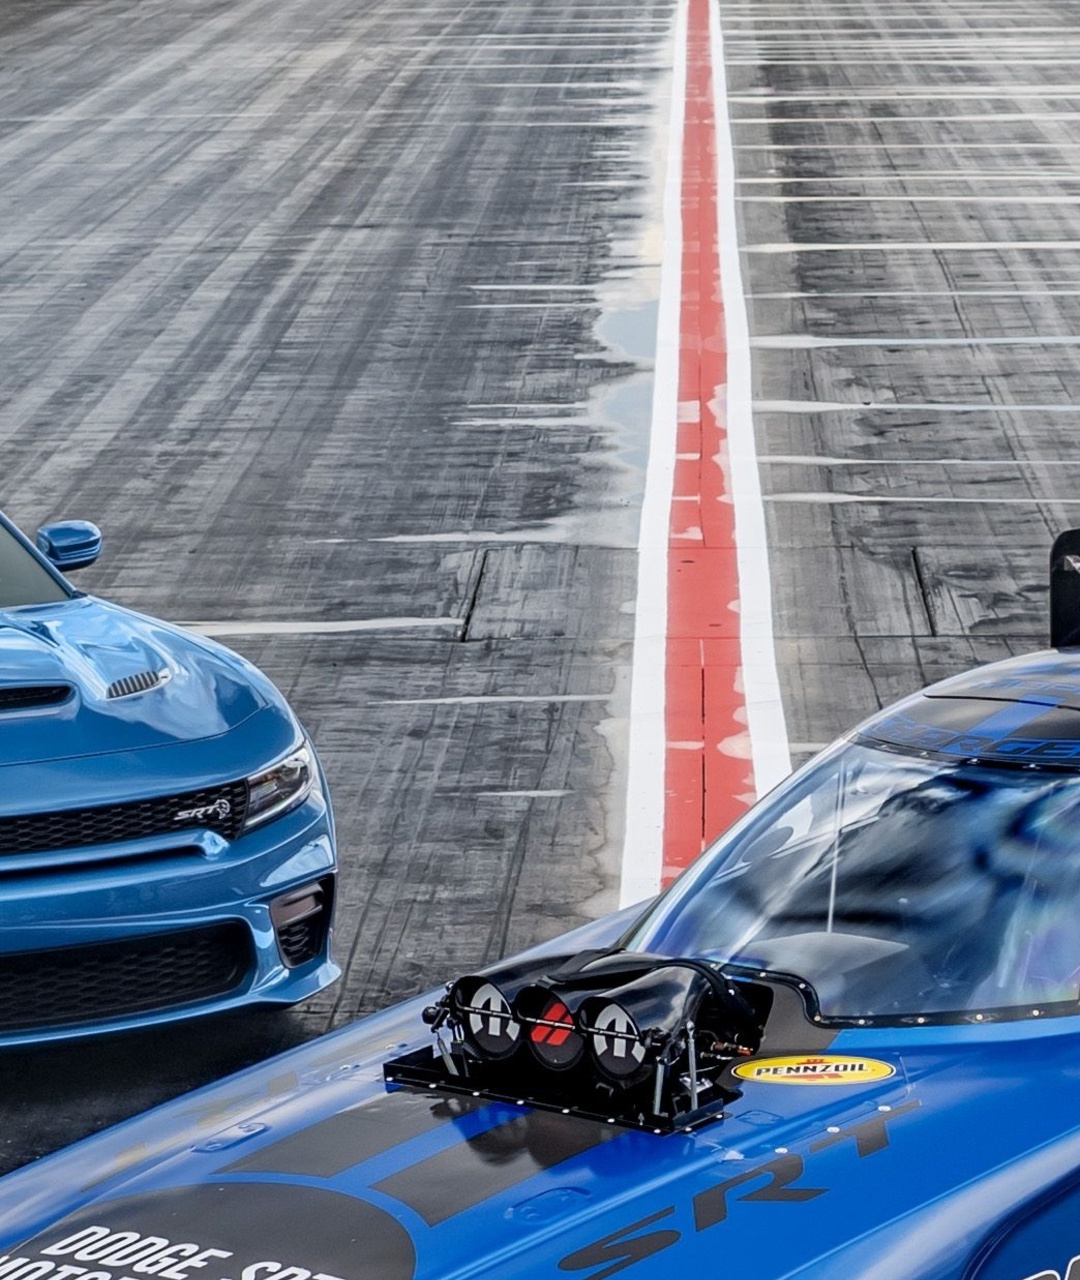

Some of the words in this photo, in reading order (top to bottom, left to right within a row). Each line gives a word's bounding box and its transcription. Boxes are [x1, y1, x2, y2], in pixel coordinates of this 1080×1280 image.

[173, 804, 219, 821] SRT
[755, 1063, 869, 1076] PENNZOIL
[39, 1225, 234, 1280] DODGE
